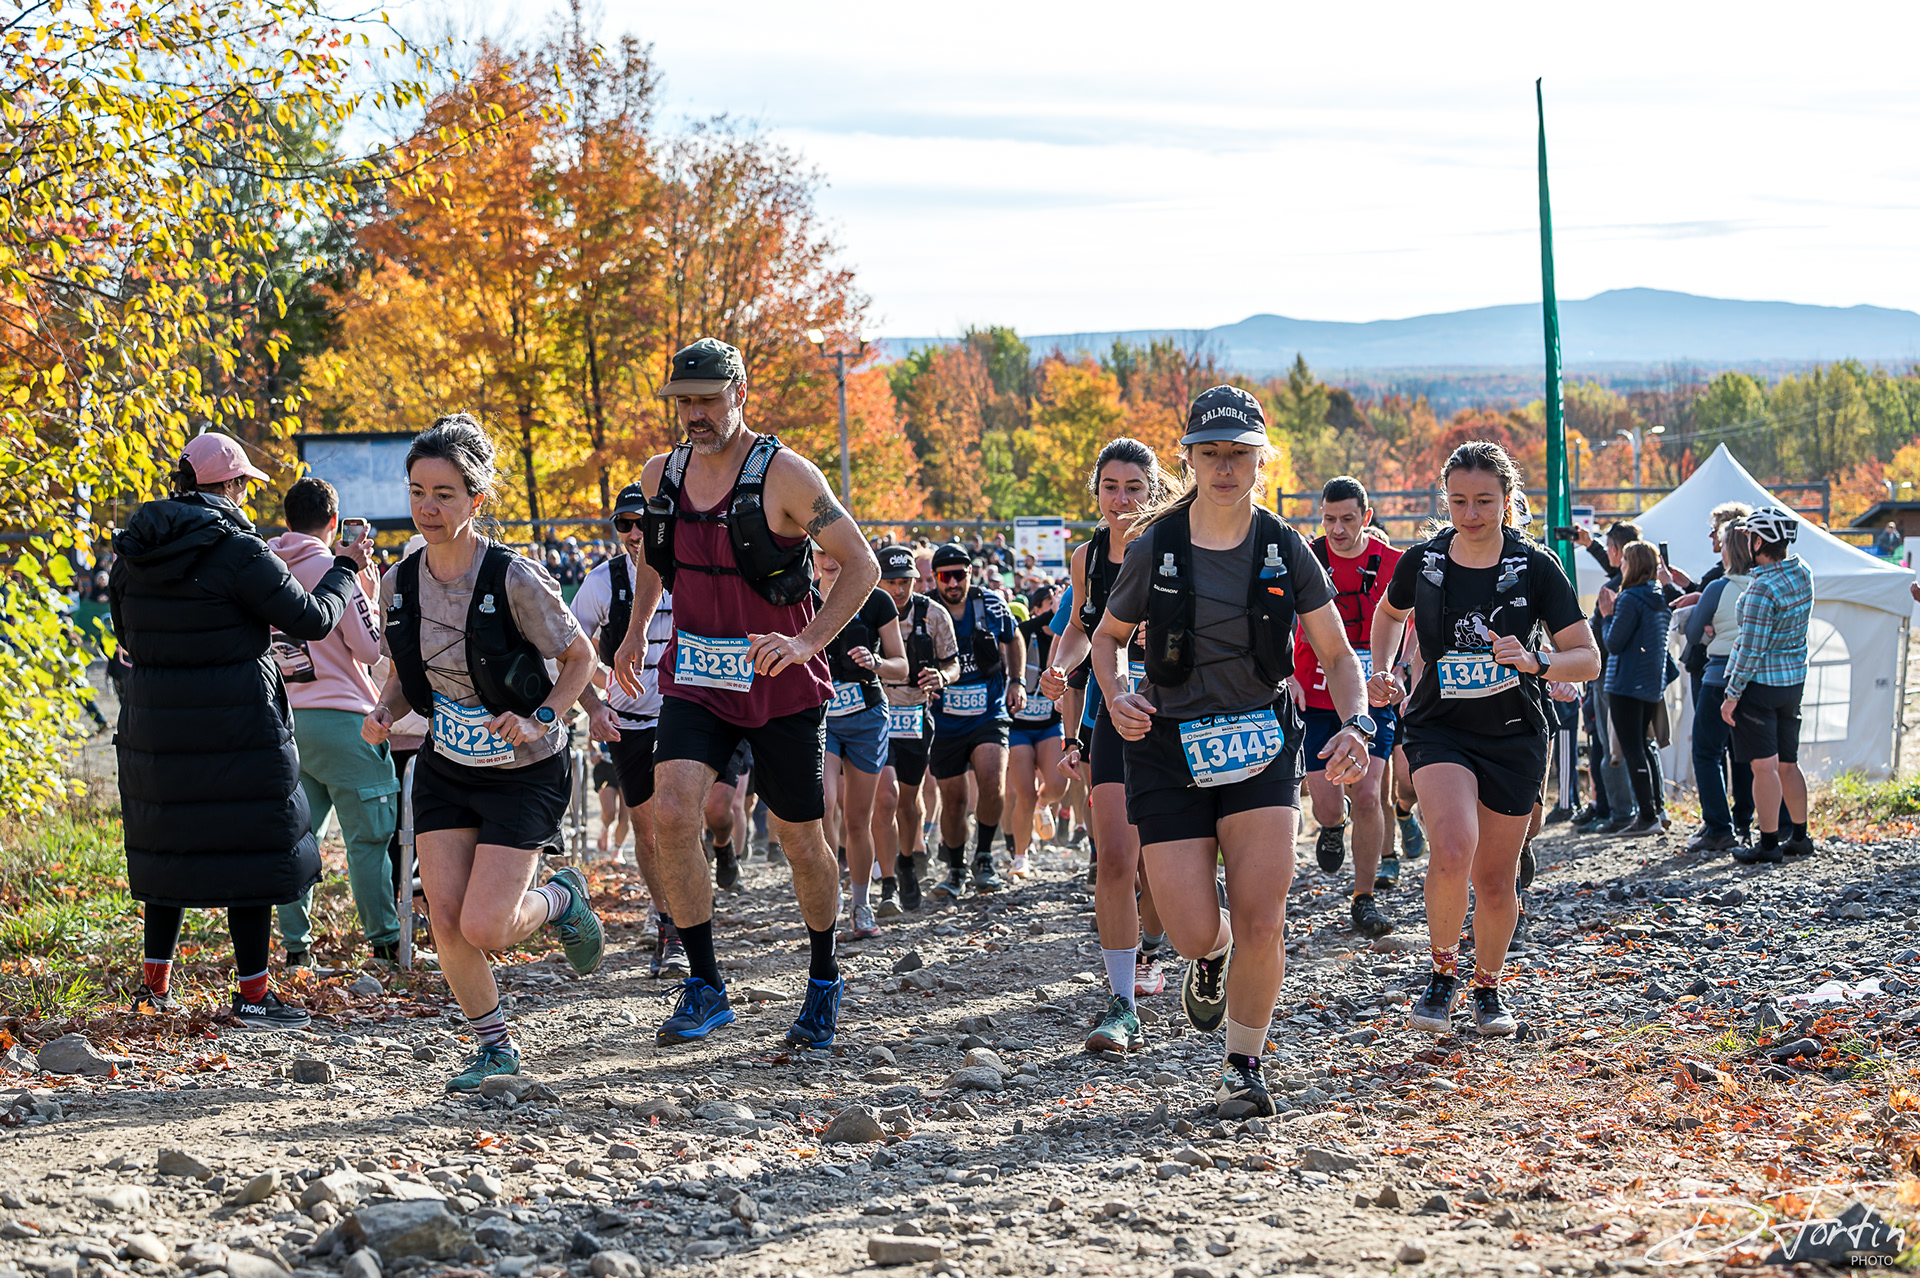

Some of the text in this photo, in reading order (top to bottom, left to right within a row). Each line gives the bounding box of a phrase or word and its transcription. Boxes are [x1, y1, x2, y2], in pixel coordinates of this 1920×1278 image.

[1201, 406, 1248, 425] BALMORAL
[1154, 584, 1178, 594] SALOMON
[679, 646, 753, 678] 13230
[944, 693, 987, 708] 13568
[1021, 702, 1054, 714] 3098
[1188, 728, 1282, 771] 13445
[240, 1004, 266, 1015] HOKA
